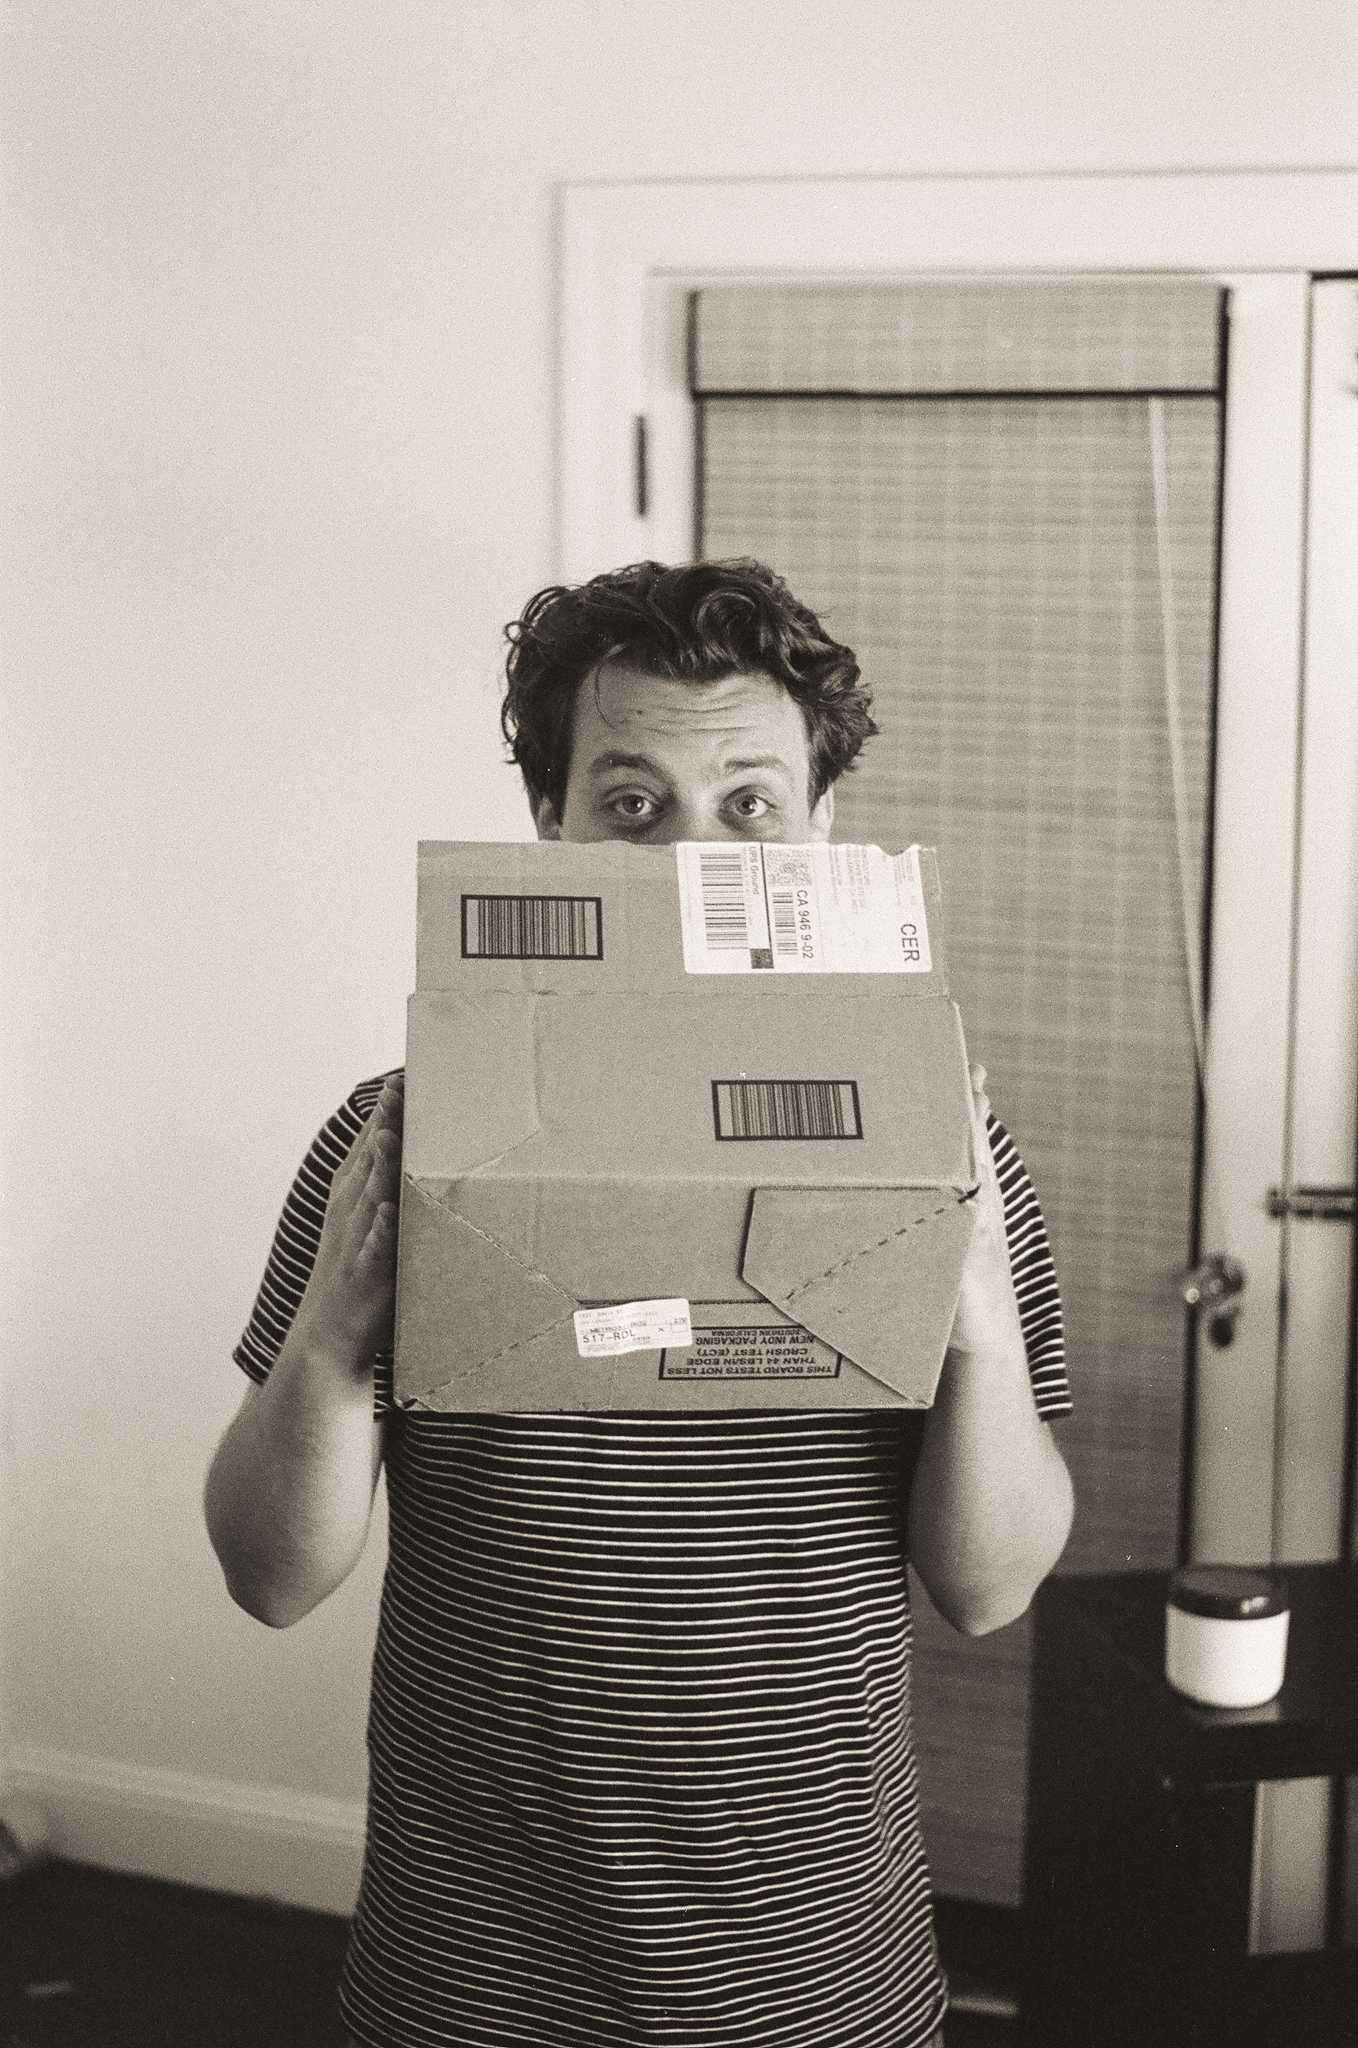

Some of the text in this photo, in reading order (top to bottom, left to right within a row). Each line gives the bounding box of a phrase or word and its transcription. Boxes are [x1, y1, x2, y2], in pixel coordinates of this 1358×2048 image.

[750, 865, 760, 895] Ground
[797, 890, 808, 907] CA
[901, 923, 920, 961] CER
[696, 1335, 815, 1345] NEW INDY PACKAGING
[697, 1347, 730, 1356] (ECT)
[733, 1348, 763, 1356] TEST
[667, 1367, 697, 1375] LESS
[763, 1366, 804, 1374] BOARD
[806, 1366, 832, 1374] THIS
